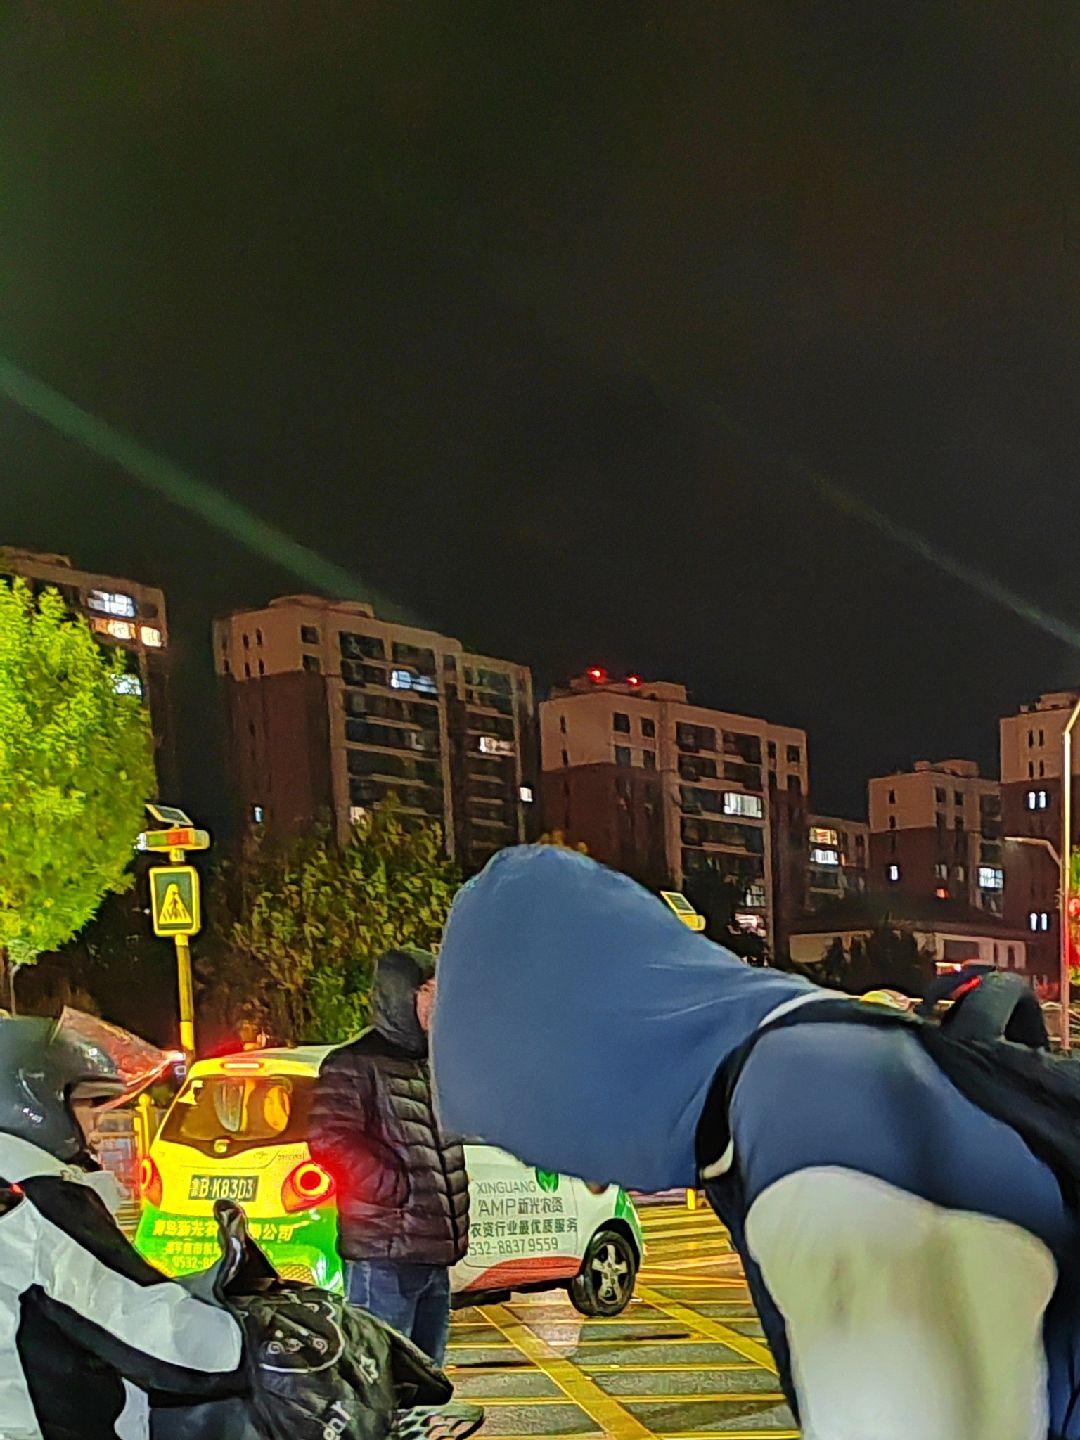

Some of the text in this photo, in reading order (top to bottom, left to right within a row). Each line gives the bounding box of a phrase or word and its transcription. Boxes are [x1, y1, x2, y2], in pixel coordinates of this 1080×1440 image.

[475, 1180, 537, 1195] XINGUANG
[470, 1217, 578, 1239] 农资行业最优质服务
